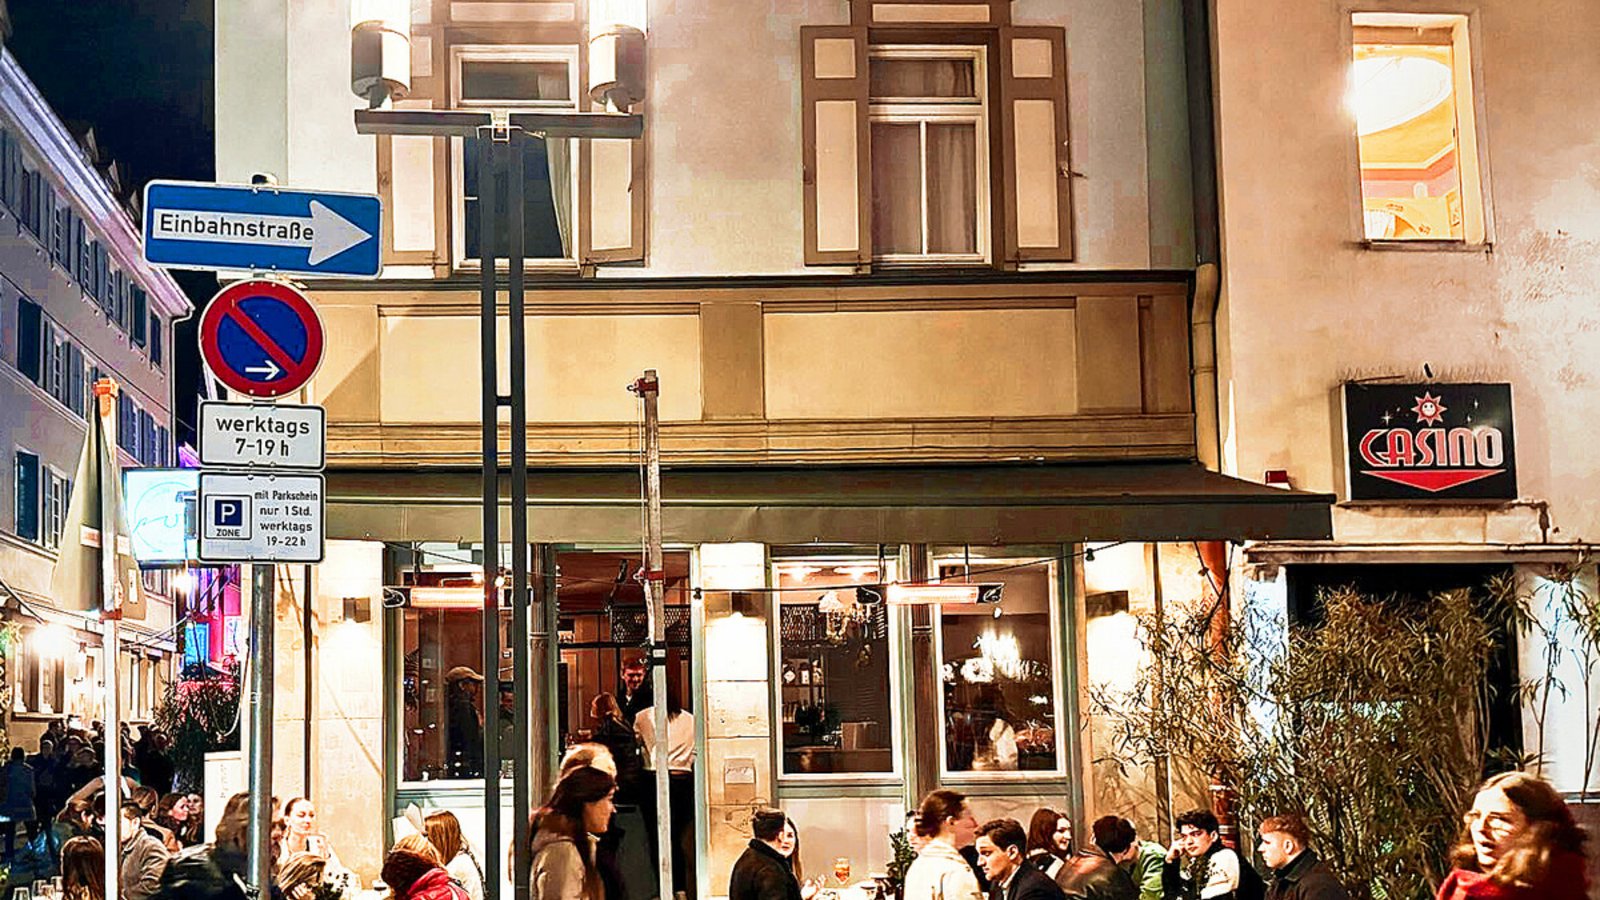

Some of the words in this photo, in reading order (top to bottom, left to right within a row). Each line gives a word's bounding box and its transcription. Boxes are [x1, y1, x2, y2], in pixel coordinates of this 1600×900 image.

[160, 214, 314, 240] Einbahnstraße
[216, 416, 310, 438] werktags
[281, 441, 289, 456] h
[1359, 427, 1503, 466] CASINO
[255, 491, 269, 500] mit
[273, 491, 318, 500] Parkschein
[221, 504, 235, 523] P
[260, 521, 312, 532] werktags
[267, 536, 298, 546] 19-22
[300, 537, 306, 546] h
